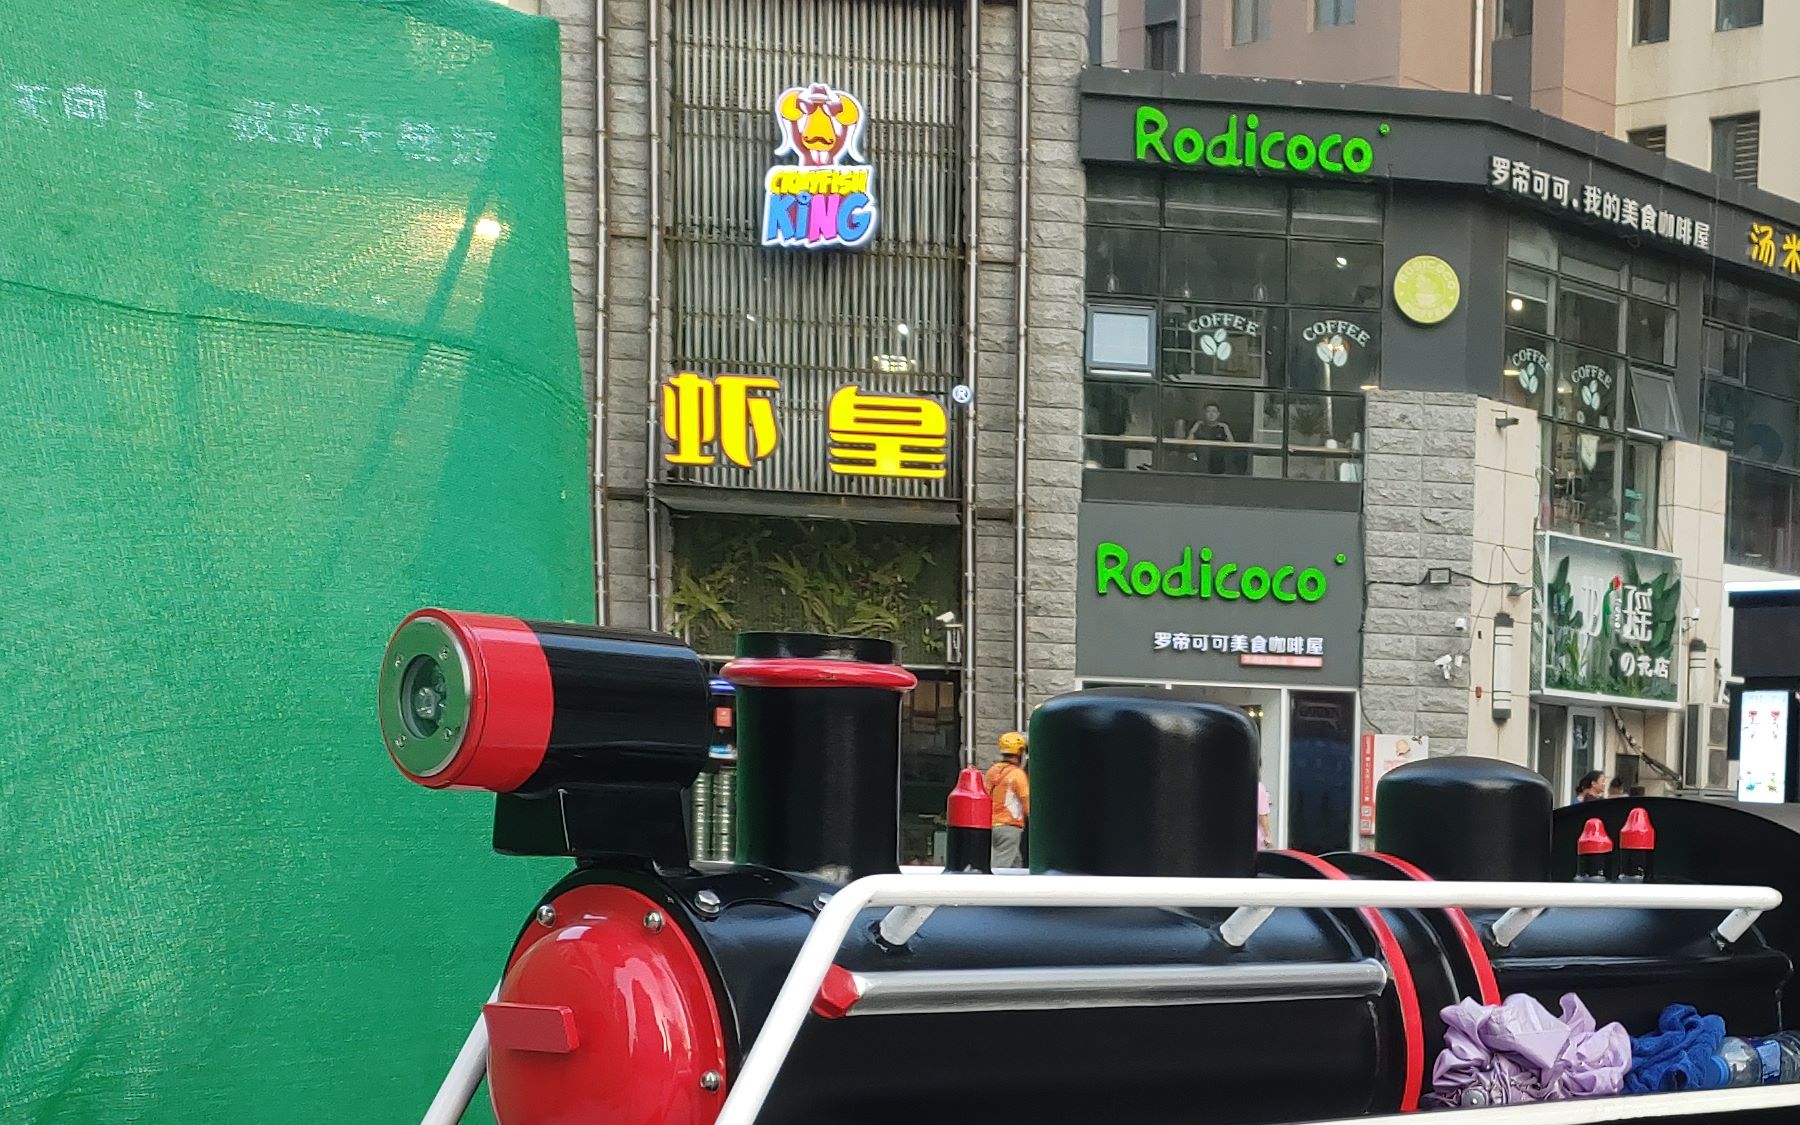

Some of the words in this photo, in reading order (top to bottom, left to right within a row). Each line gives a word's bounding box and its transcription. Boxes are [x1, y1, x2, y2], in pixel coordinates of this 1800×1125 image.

[1135, 105, 1374, 174] Rodicoco
[1187, 313, 1260, 337] COFFEE
[1302, 320, 1371, 347] COFFEE
[1570, 364, 1612, 390] COFFEE
[1096, 542, 1328, 602] Rodicoco
[1153, 631, 1324, 655] 罗帝可可美食咖啡屋
